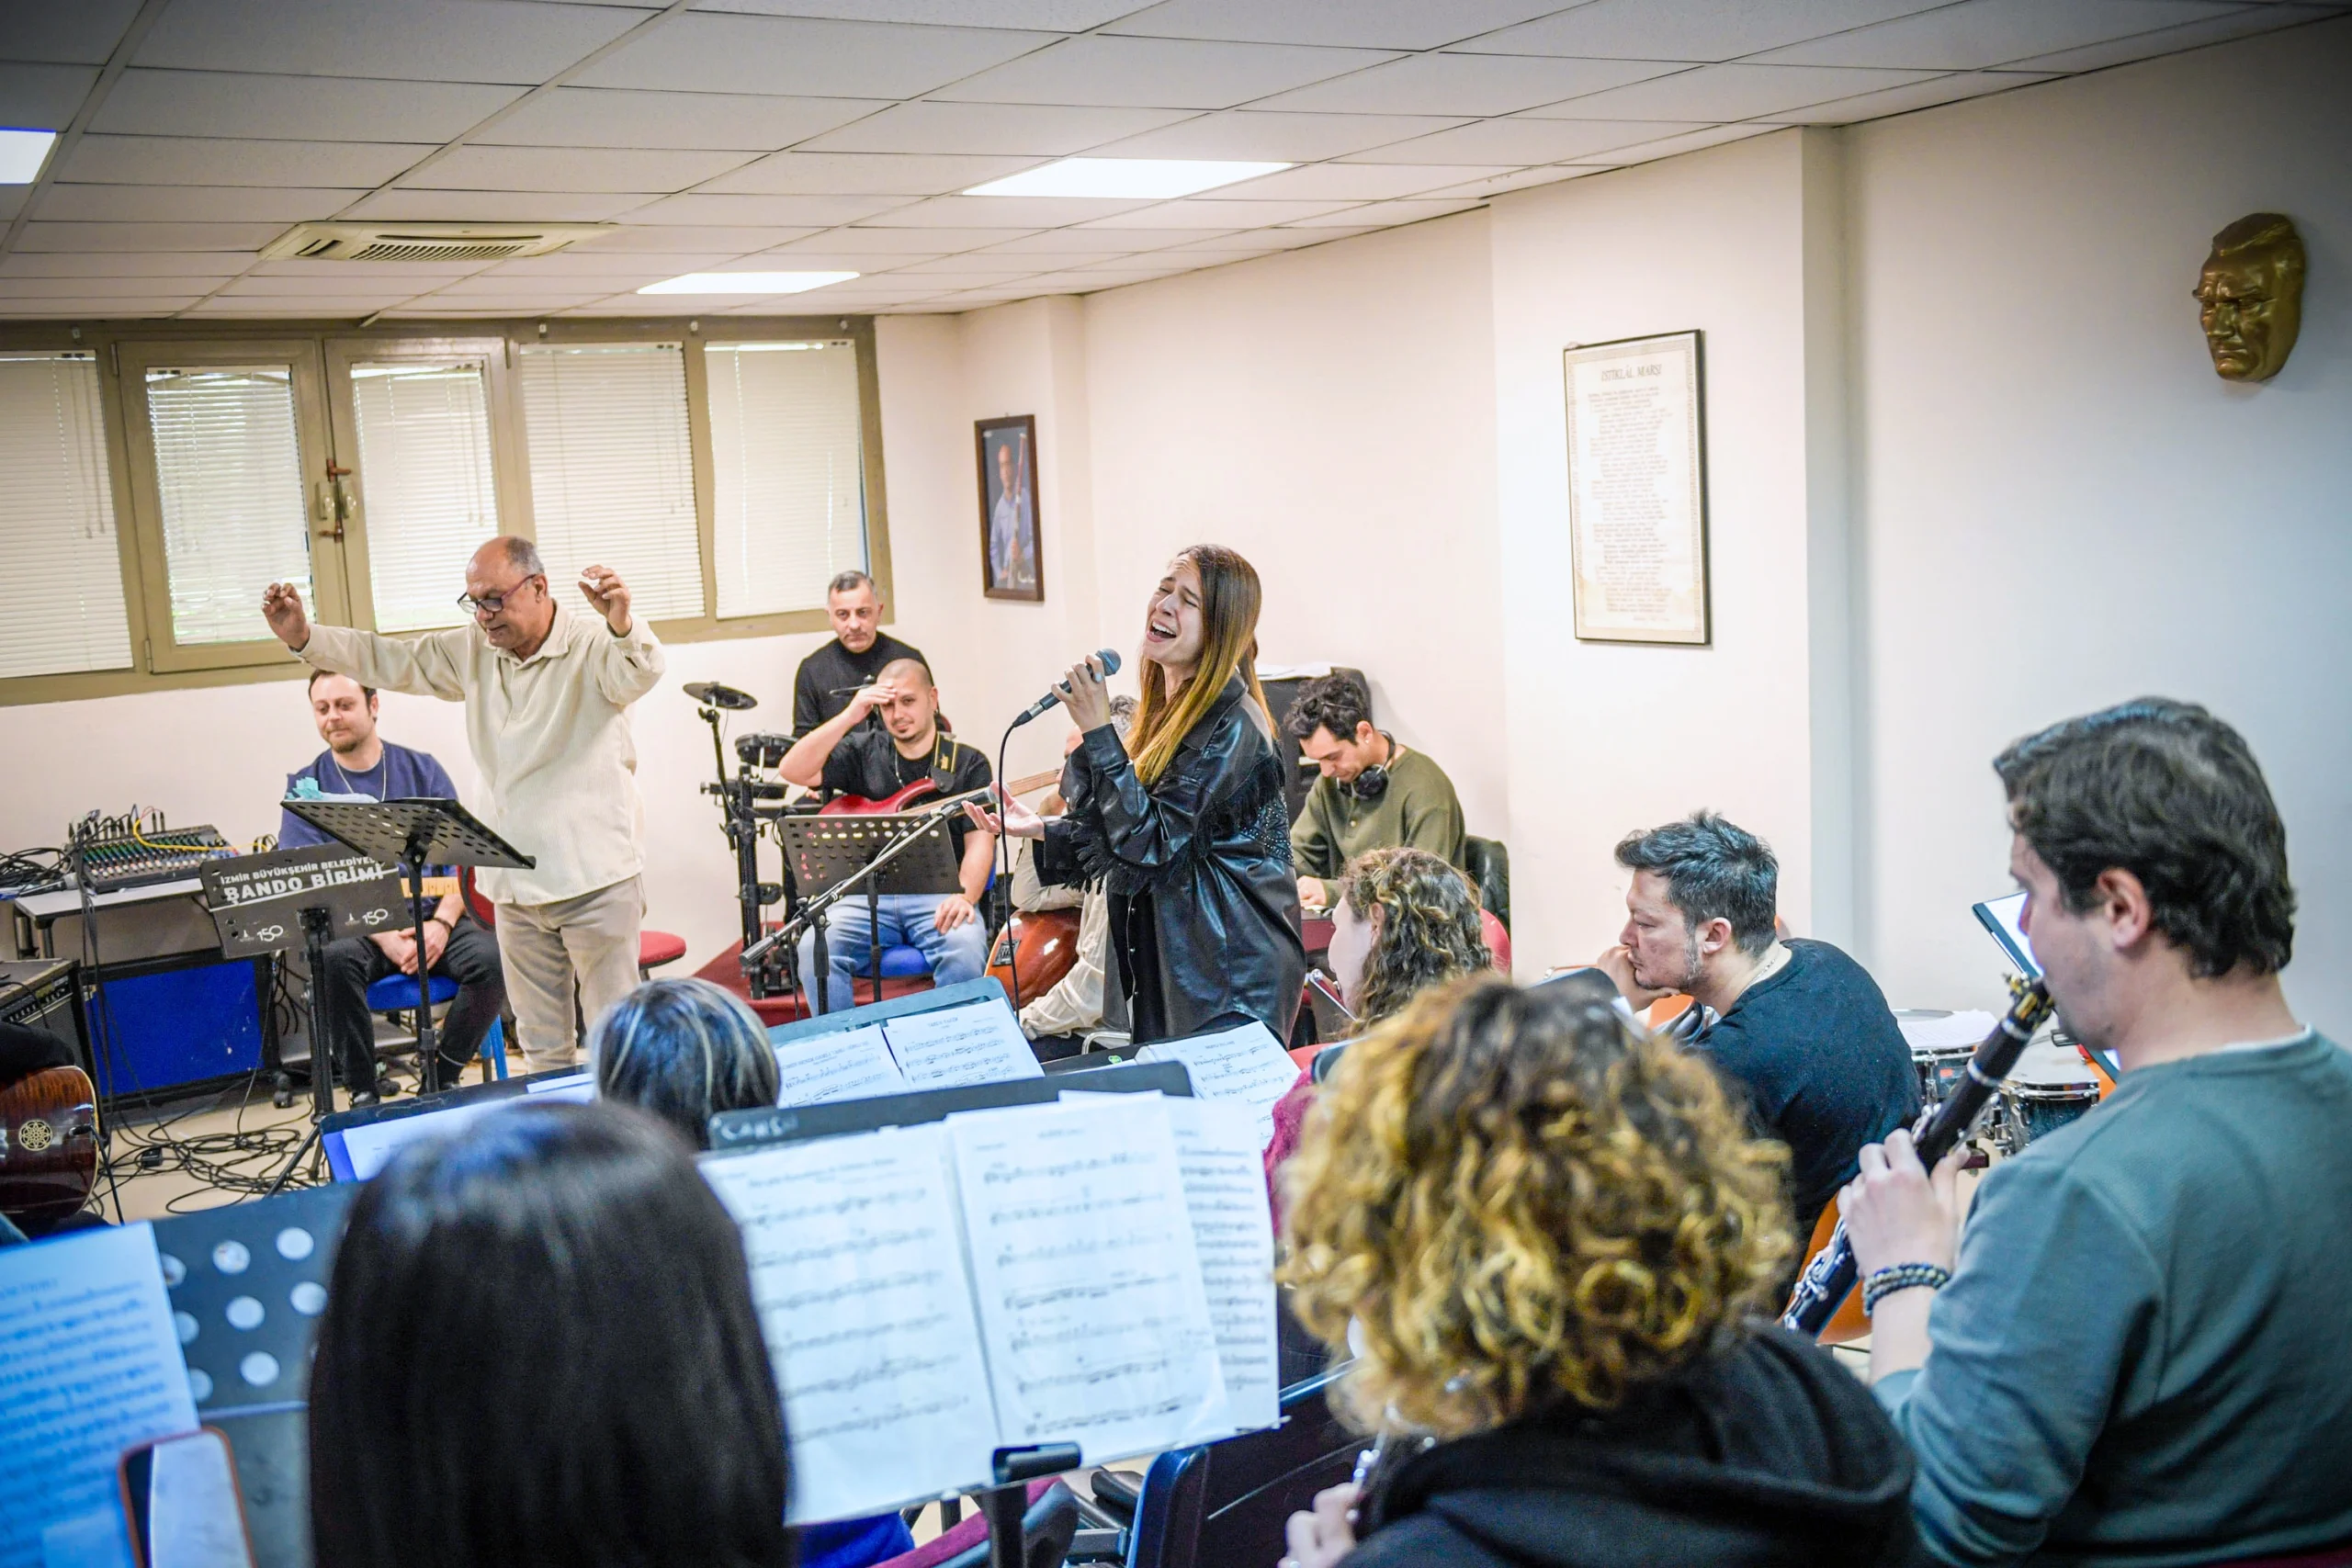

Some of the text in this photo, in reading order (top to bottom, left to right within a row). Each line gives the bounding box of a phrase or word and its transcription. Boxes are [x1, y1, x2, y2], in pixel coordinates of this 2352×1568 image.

[220, 872, 251, 885] İZMİR
[253, 863, 318, 879] BÜYÜKŞEHİR
[224, 862, 383, 901] BANDO BİRİMİ
[362, 908, 389, 925] 150
[257, 924, 284, 942] 150
